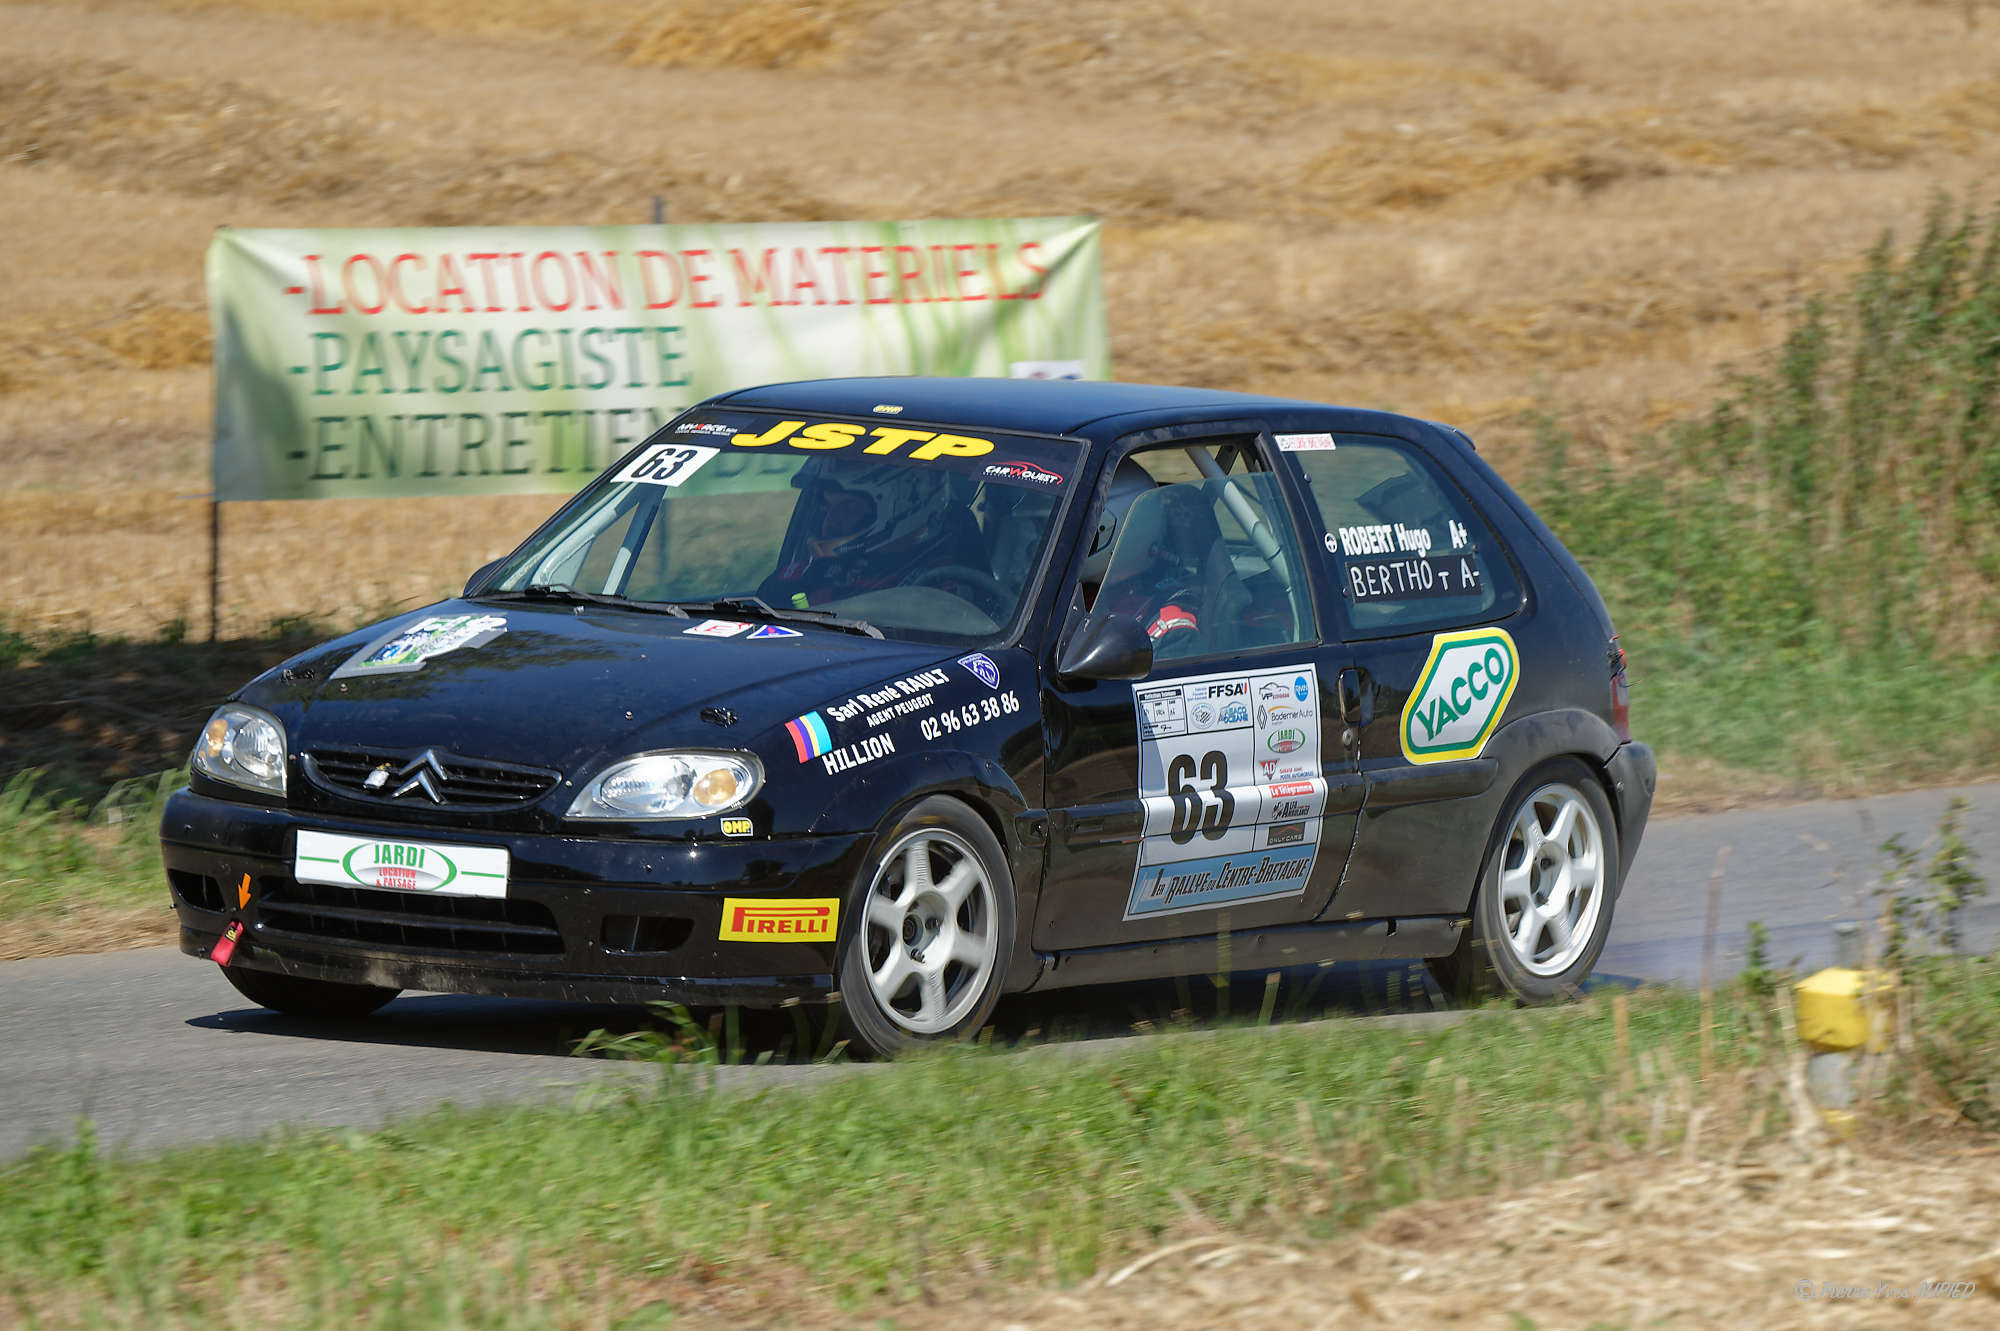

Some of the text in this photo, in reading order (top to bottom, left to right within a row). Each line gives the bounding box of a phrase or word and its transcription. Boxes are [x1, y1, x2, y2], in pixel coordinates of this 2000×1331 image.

[635, 249, 718, 309] DE
[726, 241, 1050, 307] MATERIELS
[730, 420, 995, 460] JSTP
[631, 448, 698, 480] 63
[1339, 520, 1467, 558] ROBERT Hugo A+
[1350, 560, 1433, 597] BERTHO
[1461, 558, 1480, 588] A-
[826, 668, 950, 722] Sarl René RAULT
[1209, 683, 1244, 698] FFSA
[1416, 648, 1505, 741] YACCO
[866, 693, 934, 728] AGENT PEUGEOT
[822, 690, 1020, 776] HILLION 02 96 63 38 86
[1263, 761, 1275, 776] AD
[1168, 750, 1235, 845] 63
[723, 820, 751, 834] OMP
[374, 844, 426, 868] JARDI
[379, 867, 417, 878] LOCATION
[383, 878, 417, 890] PAYSAGE
[1164, 872, 1211, 904] RALLYE
[1216, 856, 1311, 889] CENTRE-BRETAGNE
[731, 907, 830, 933] PIRELLI
